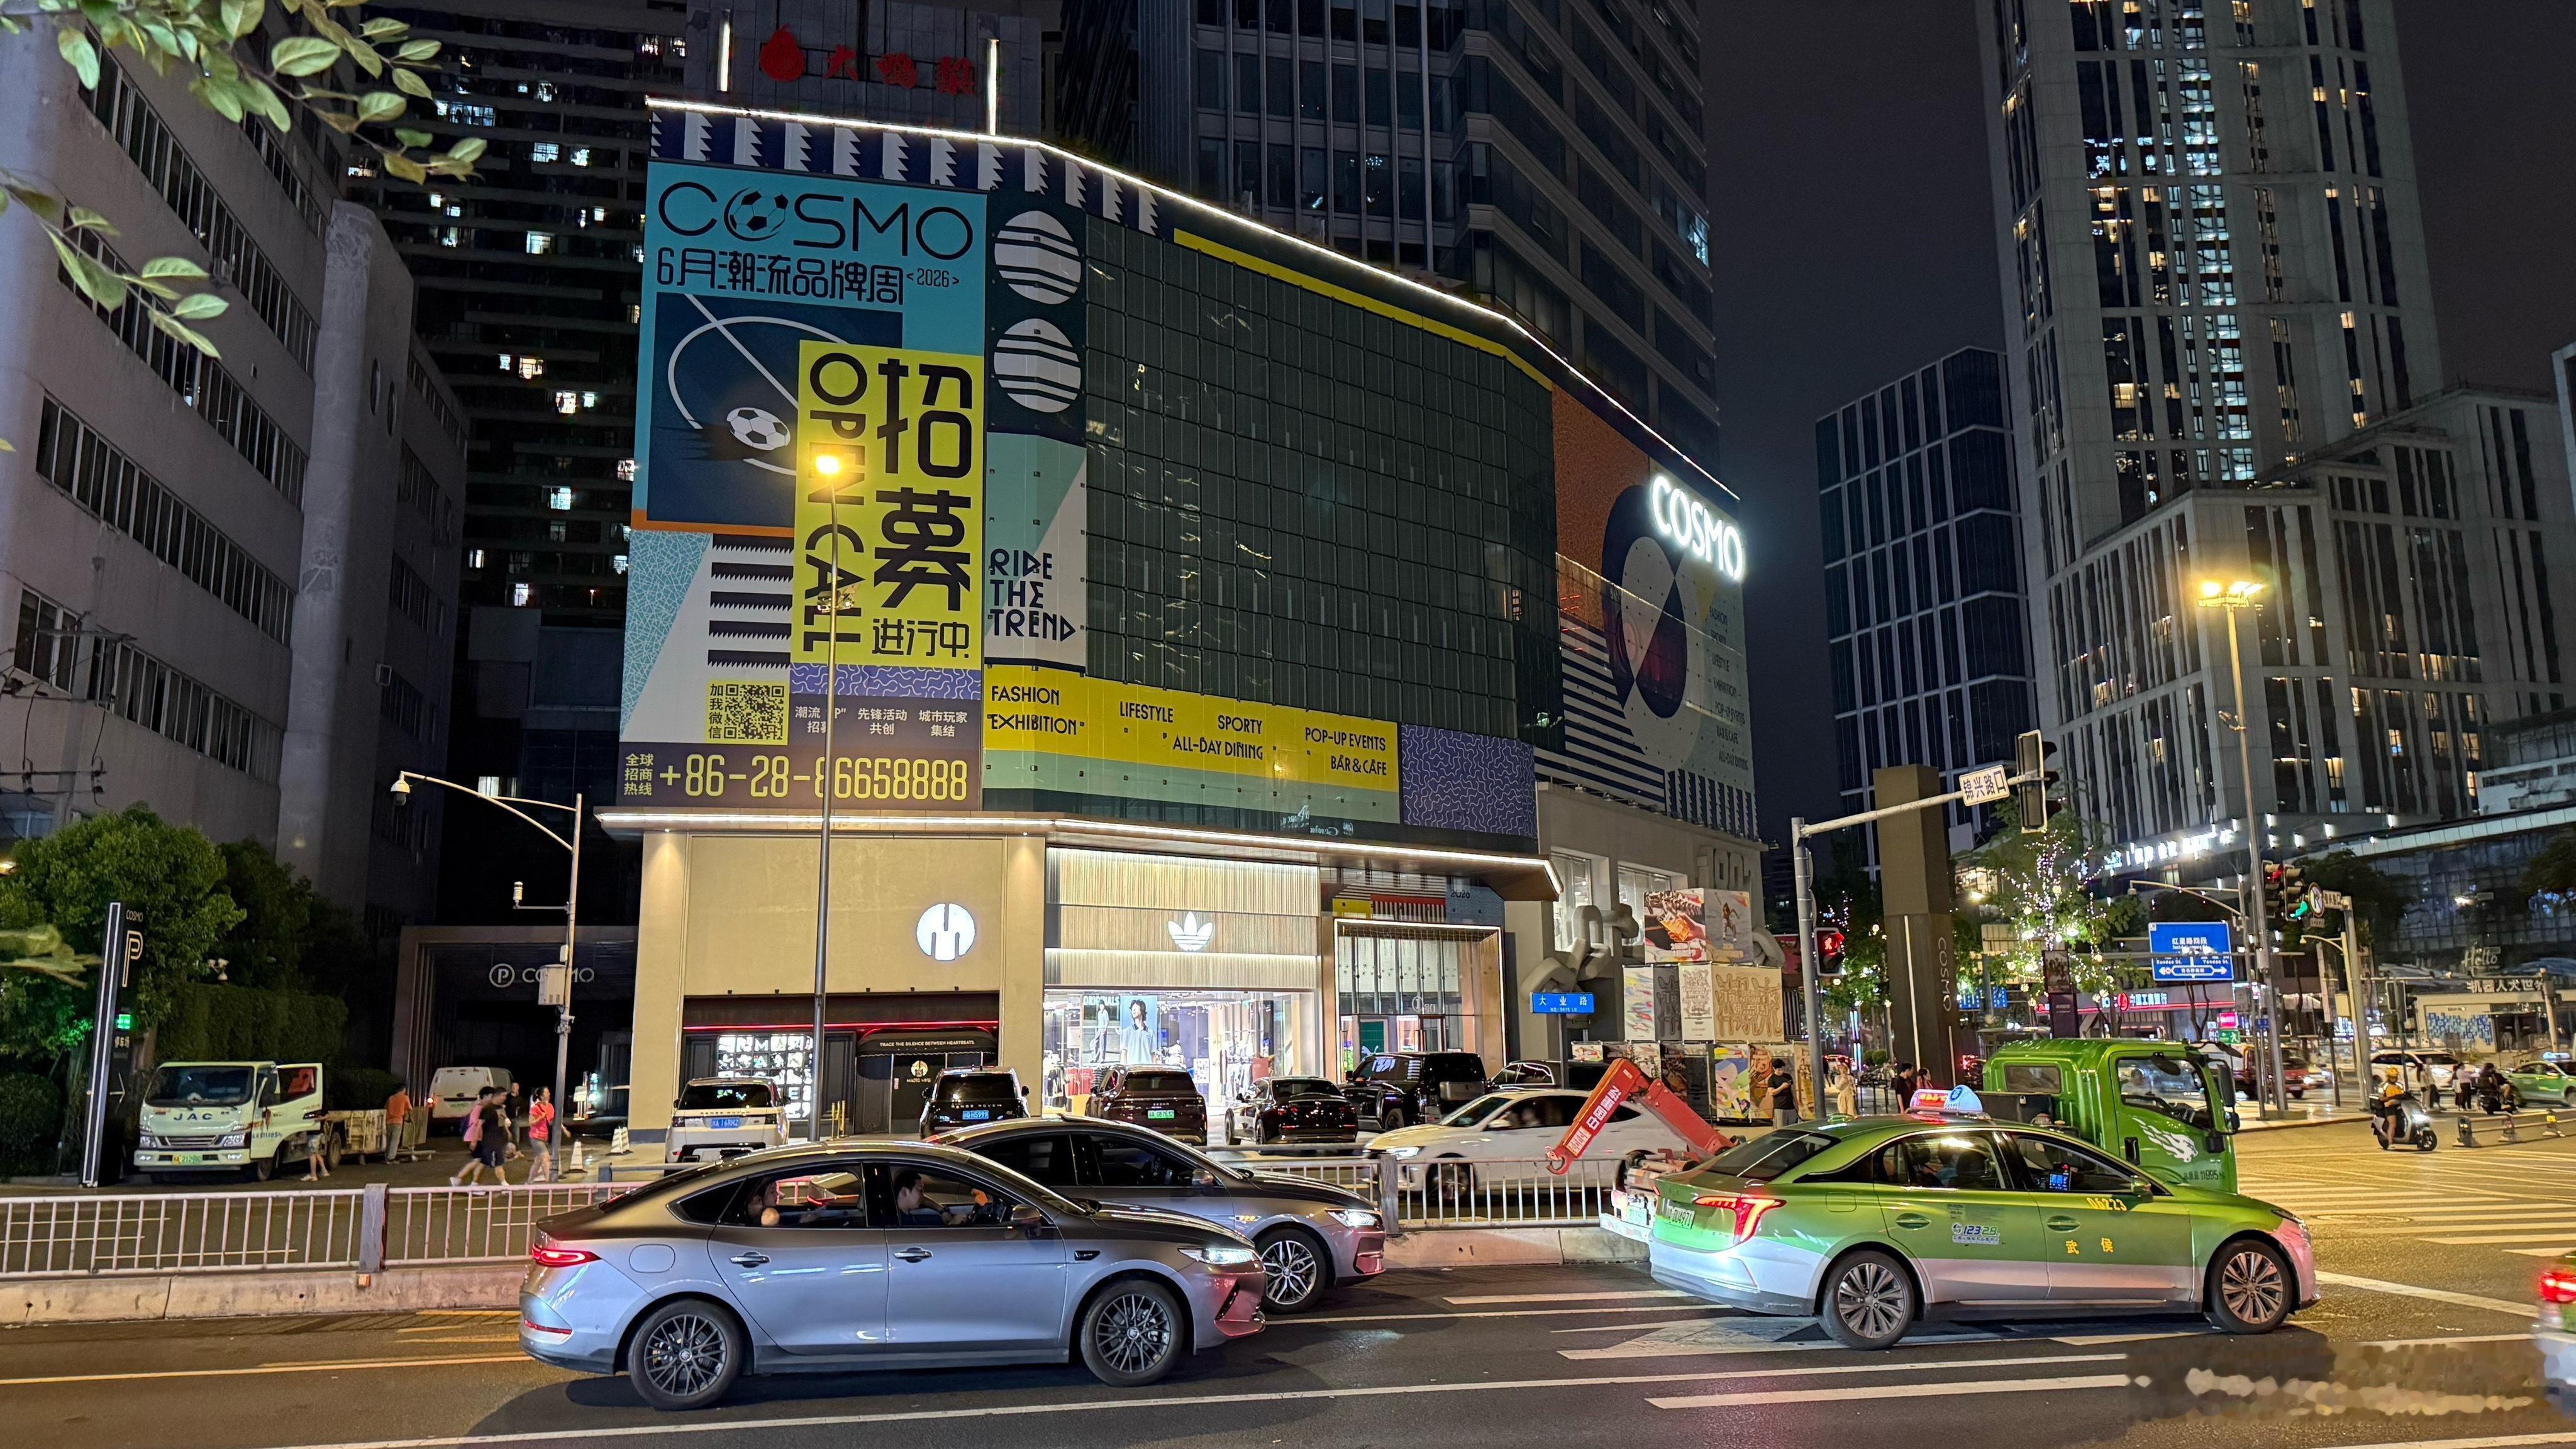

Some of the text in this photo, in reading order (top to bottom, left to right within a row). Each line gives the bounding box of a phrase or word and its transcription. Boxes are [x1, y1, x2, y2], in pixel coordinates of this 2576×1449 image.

[658, 181, 973, 260] COSMO
[657, 247, 903, 305] 6月潮流品牌周
[803, 352, 868, 652] OPEN CALL
[1652, 475, 1743, 580] COSMO
[990, 548, 1053, 580] RIDE
[991, 579, 1044, 609] THE
[990, 609, 1076, 642] TREND
[991, 686, 1060, 706] FASHION
[709, 684, 724, 739] 加我微信
[858, 708, 908, 721] 先锋活动
[919, 710, 967, 723] 城市玩家
[1119, 701, 1174, 723] LIFESTYLE
[870, 723, 895, 735] 共创
[930, 725, 955, 737] 集结
[991, 714, 1077, 735] EXHIBITION
[1218, 714, 1262, 735] SPORTY
[1172, 736, 1263, 760] ALL-DAY DINING
[1305, 726, 1386, 752] POP-UP EVENTS
[626, 753, 654, 767] 全球
[625, 768, 653, 781] 招商
[624, 782, 652, 796] 热线
[126, 910, 143, 922] COSMO
[122, 930, 143, 988] P
[1938, 936, 1951, 1012] COSMO
[1539, 995, 1587, 1006] 大业路
[174, 1113, 213, 1121] JAC
[2086, 1197, 2127, 1212] 06223
